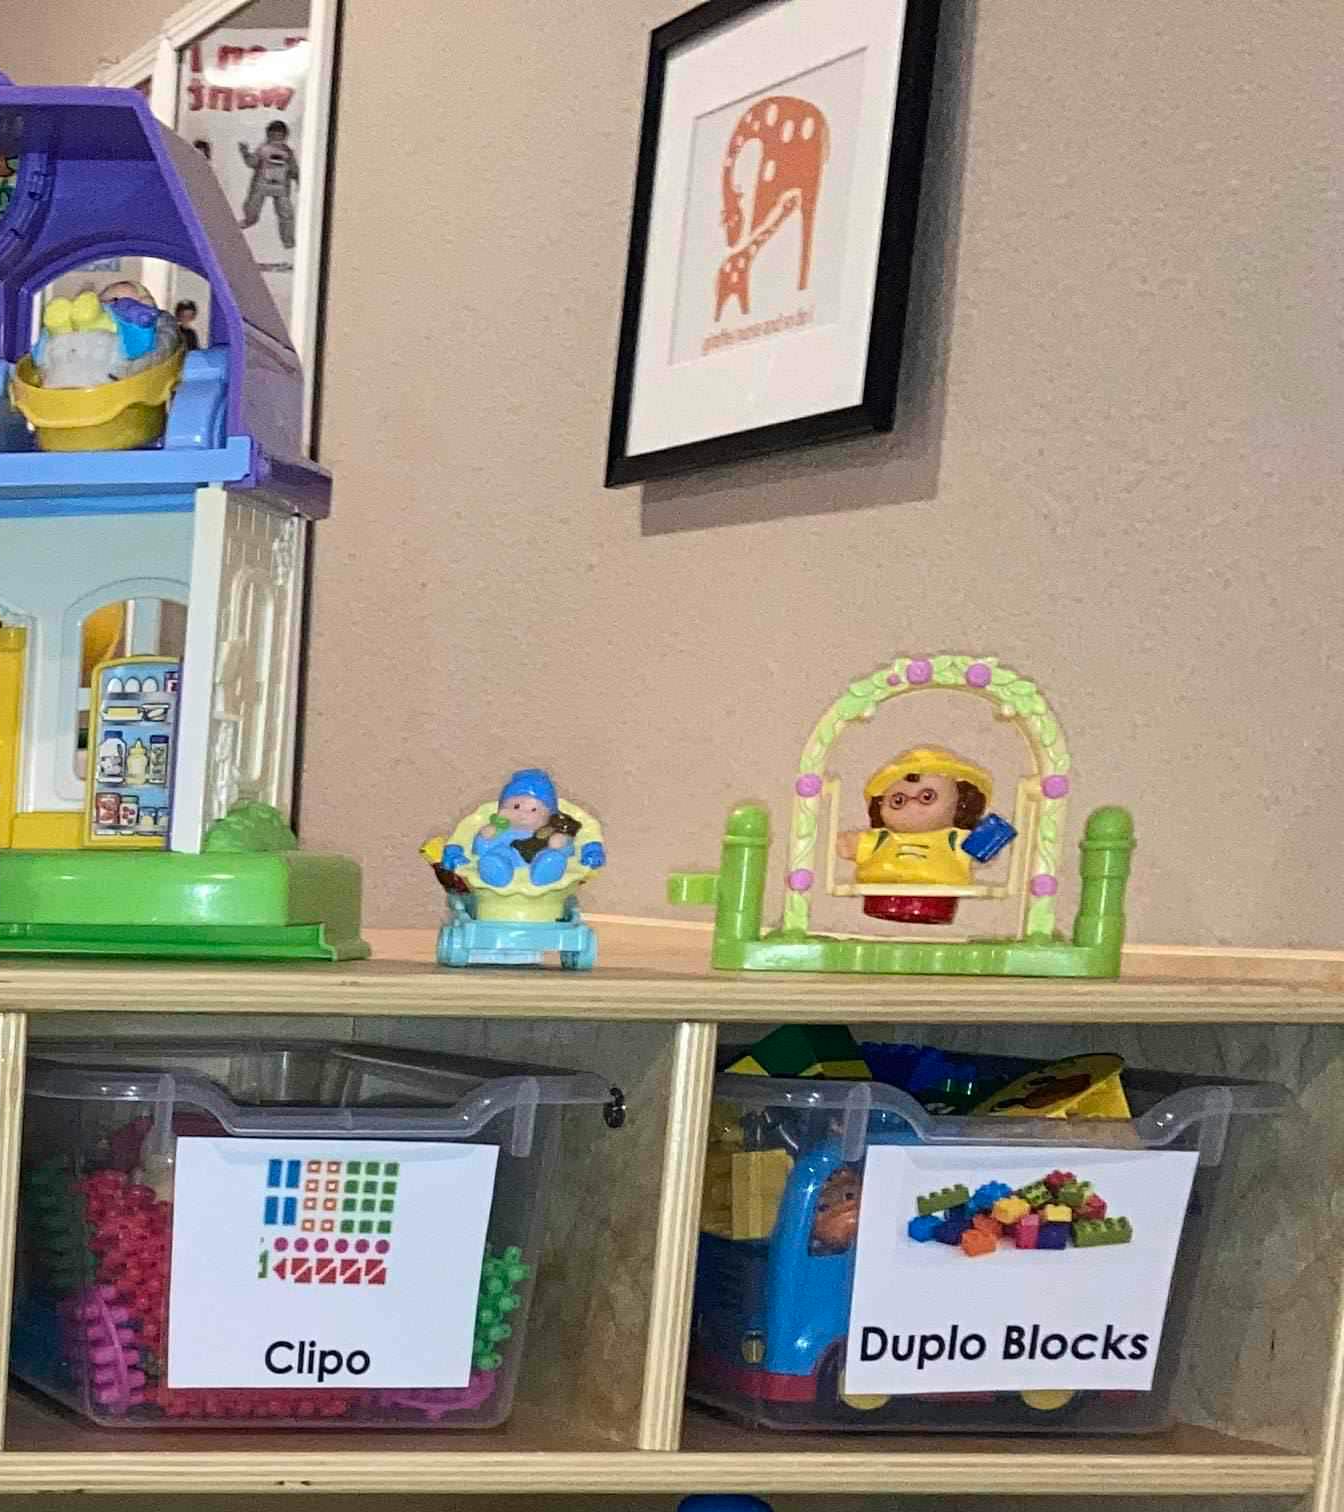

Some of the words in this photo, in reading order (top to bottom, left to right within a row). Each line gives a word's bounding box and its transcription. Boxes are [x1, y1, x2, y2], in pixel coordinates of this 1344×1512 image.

[264, 1341, 372, 1382] Clipo
[860, 1325, 987, 1369] Duplo
[1002, 1325, 1148, 1362] Blocks
